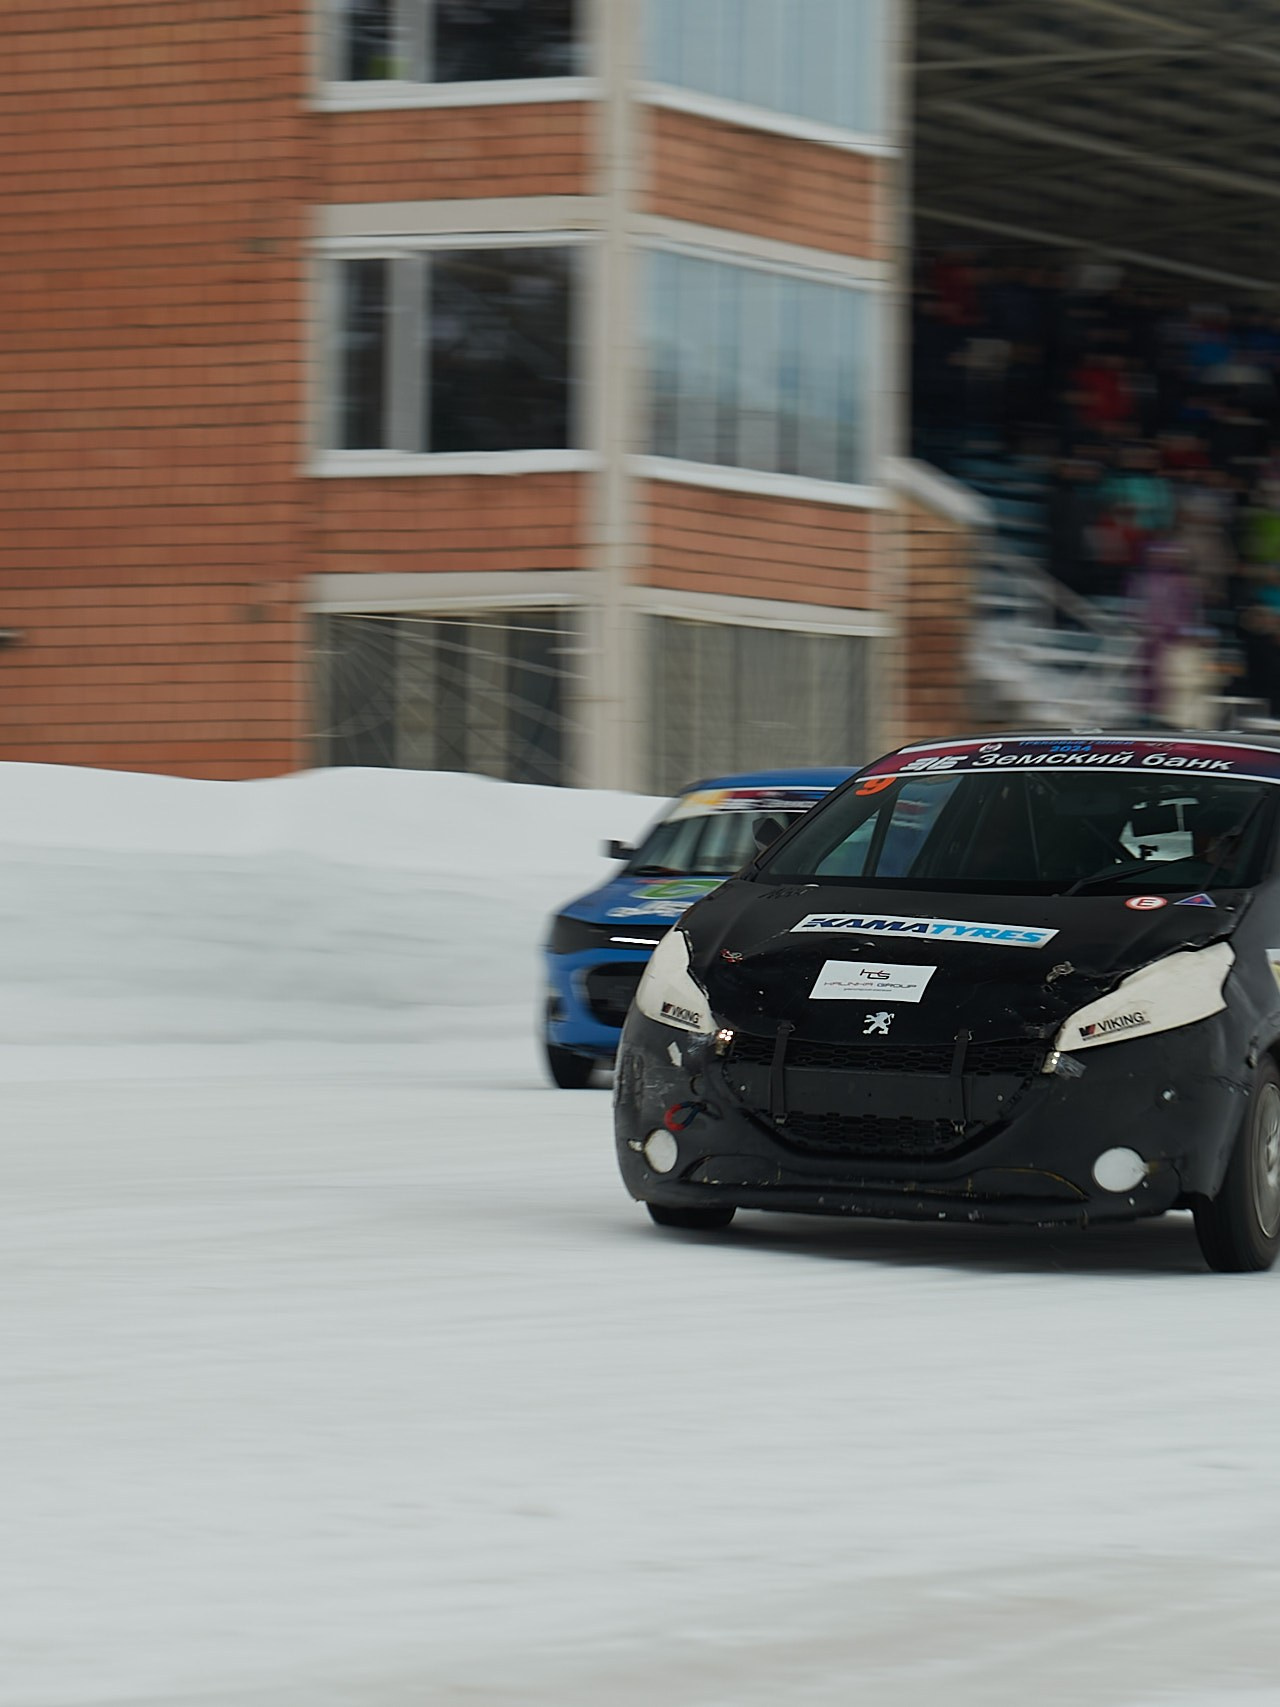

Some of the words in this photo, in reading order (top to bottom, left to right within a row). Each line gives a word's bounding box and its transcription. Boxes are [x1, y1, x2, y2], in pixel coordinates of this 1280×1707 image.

[972, 751, 1135, 767] Земский
[1141, 753, 1235, 771] банк
[855, 776, 897, 796] 9
[1136, 898, 1158, 908] E
[1097, 1011, 1145, 1032] VIKING
